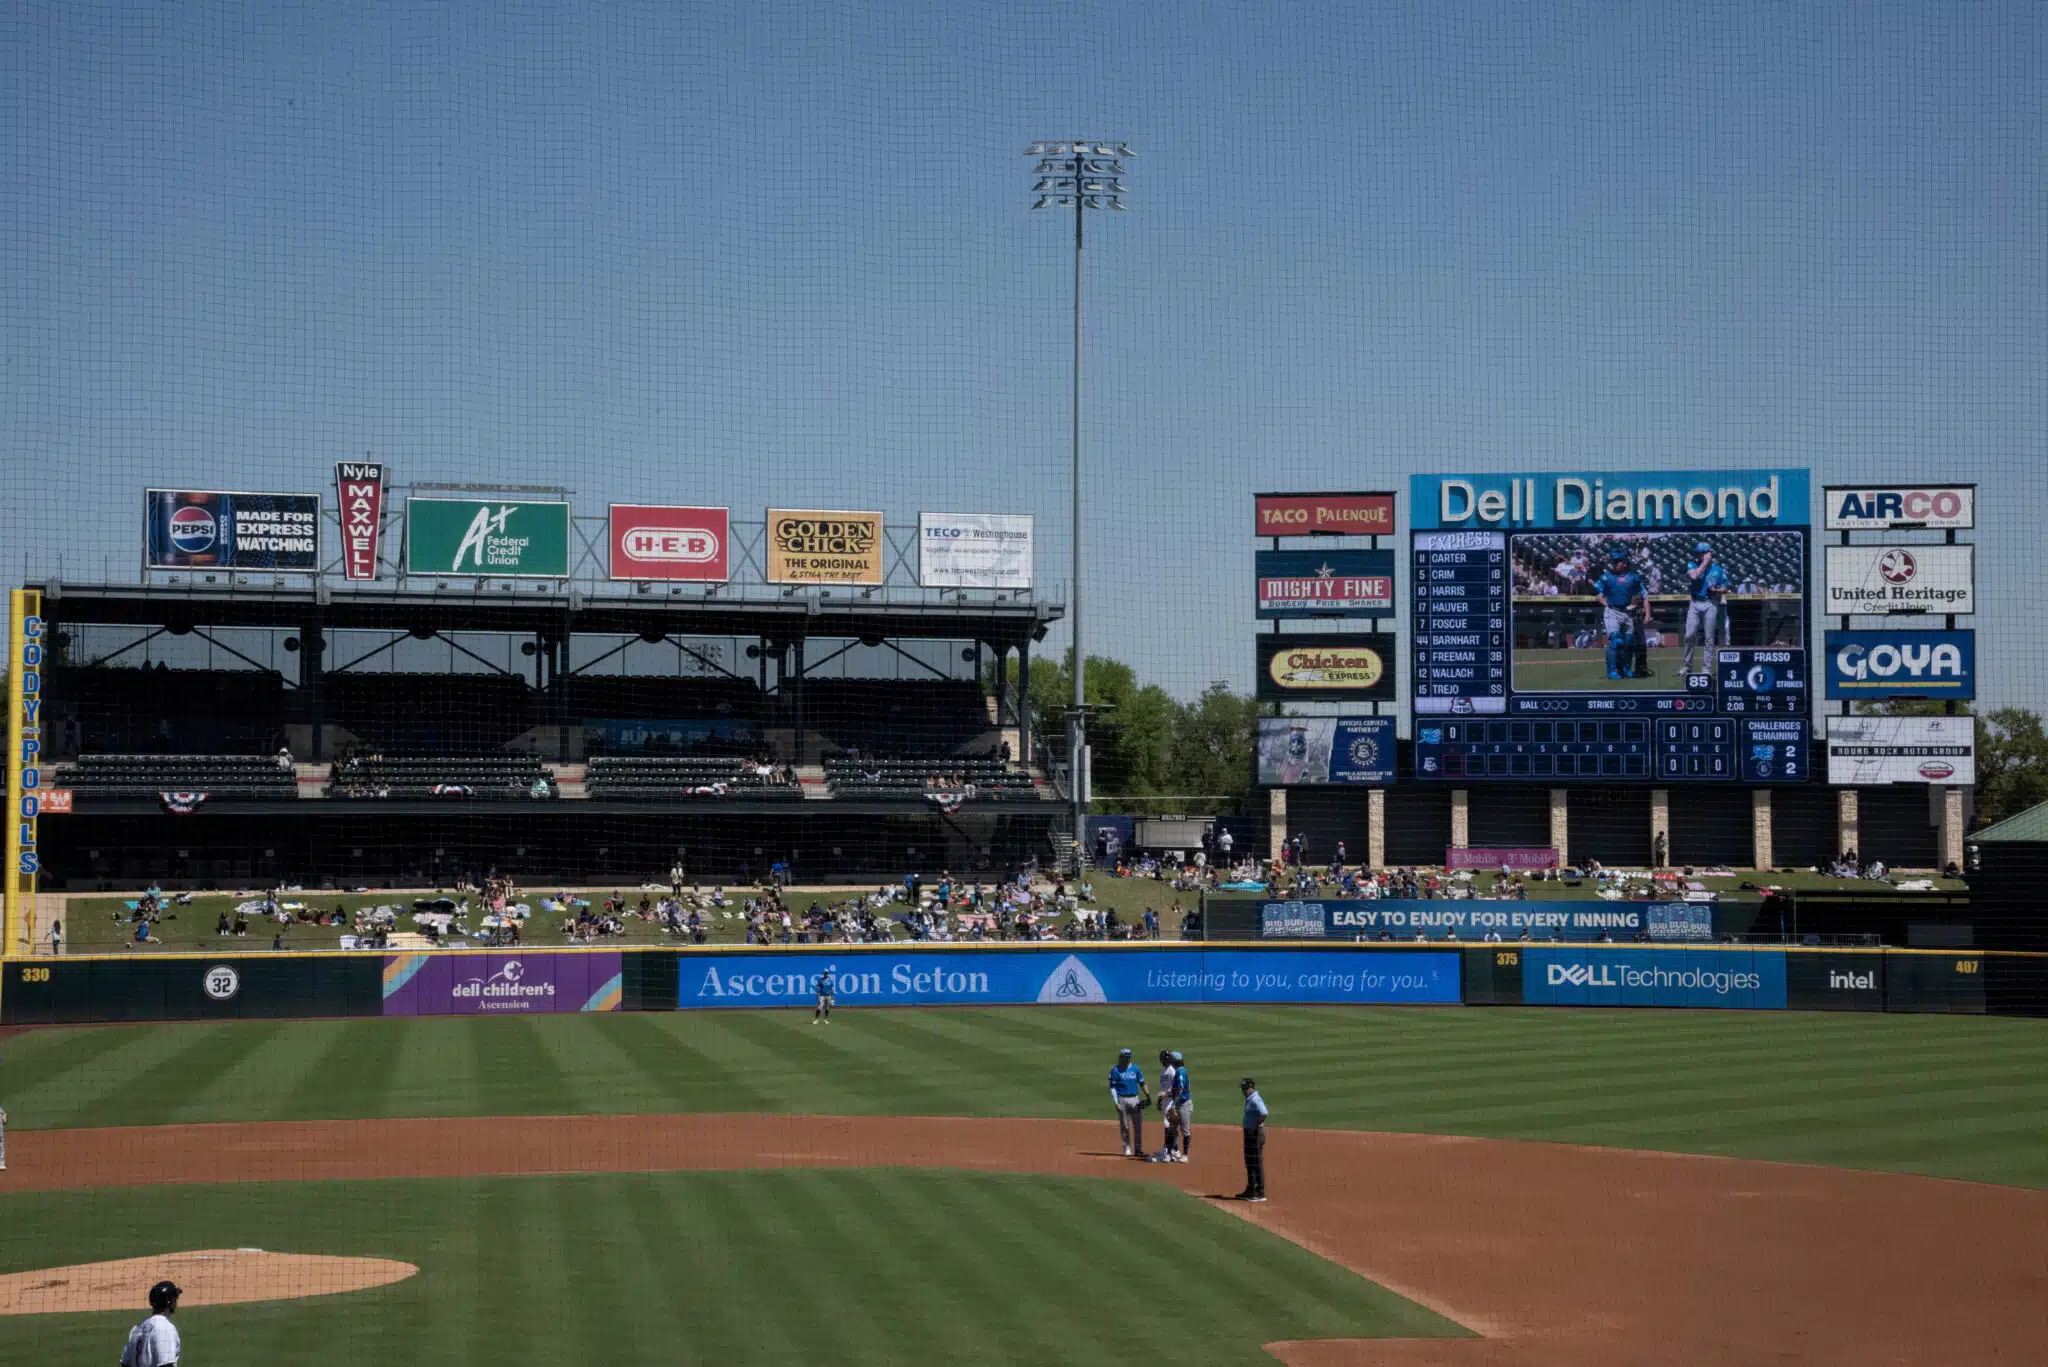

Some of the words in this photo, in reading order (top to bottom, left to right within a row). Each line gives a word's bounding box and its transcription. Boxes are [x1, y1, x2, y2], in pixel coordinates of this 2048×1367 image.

[343, 463, 379, 481] Nyle
[1441, 479, 1534, 522] Dell
[1556, 475, 1779, 521] Diamond
[235, 511, 280, 521] MADE
[283, 511, 313, 523] FOR
[1261, 508, 1308, 524] TACO
[1316, 507, 1388, 524] PALENQUE
[171, 524, 214, 537] PEPSI
[235, 522, 313, 536] EXPRESS
[347, 484, 375, 577] MAXWELL
[778, 519, 875, 539] GOLDEN
[925, 527, 960, 538] TECO
[973, 529, 1028, 542] Westinghouse
[236, 537, 313, 552] WATCHING
[453, 505, 519, 572] A+
[487, 535, 529, 547] Federal
[1428, 531, 1491, 551] EXPRESS
[487, 545, 521, 556] Credit
[786, 536, 861, 555] CHICK
[487, 555, 519, 566] Union
[1419, 553, 1425, 563] 11
[1431, 553, 1467, 563] CARTER
[1489, 553, 1502, 563] CF
[785, 559, 808, 569] THE
[810, 559, 870, 571] ORIGINAL
[799, 571, 821, 581] STILL
[823, 572, 843, 582] THE
[844, 572, 864, 582] BEST
[1418, 569, 1425, 580] 5
[1431, 569, 1455, 580] CRIM
[1491, 569, 1501, 580] 1B
[1267, 579, 1336, 598] MIGHTY
[1344, 580, 1385, 597] FINE
[1417, 586, 1427, 596] 10
[1432, 586, 1466, 596] HARRIS
[1490, 586, 1502, 596] RF
[1831, 585, 1887, 601] United
[1891, 586, 1967, 603] Heritage
[1268, 600, 1308, 608] BURGERS
[1316, 600, 1341, 608] FRIES
[1348, 600, 1382, 608] SHAKES
[1418, 602, 1427, 613] 17
[1432, 602, 1469, 613] HAUVER
[1490, 602, 1502, 613] LF
[1863, 602, 1899, 612] Credit
[1419, 619, 1425, 629] 7
[1432, 619, 1467, 629] FOSCUE
[1490, 619, 1502, 629] 2B
[1416, 635, 1428, 646] 44
[1432, 635, 1480, 646] BARNHART
[1492, 635, 1500, 646] C
[1287, 653, 1369, 670] Chicken
[1419, 651, 1426, 662] 6
[1432, 651, 1476, 662] FREEMAN
[1490, 651, 1503, 662] 3B
[1754, 652, 1791, 662] FRASSO
[1837, 643, 1961, 681] GOYA
[23, 616, 41, 724] CODY
[1327, 671, 1370, 681] EXPRESS
[1418, 667, 1428, 678] 12
[1432, 667, 1474, 678] WALLACH
[1490, 667, 1503, 678] DH
[1730, 670, 1737, 679] 3
[1689, 676, 1708, 687] 85
[1418, 684, 1428, 695] 15
[1432, 684, 1460, 695] TREJO
[1490, 684, 1503, 695] SS
[1520, 701, 1538, 709] BALL
[1587, 700, 1615, 709] STRIKE
[1657, 700, 1673, 709] OUT
[1788, 702, 1794, 711] 3
[1748, 721, 1801, 731] CHALLENGES
[1449, 726, 1456, 739] 0
[1669, 726, 1677, 738] 0
[1692, 726, 1699, 738] 0
[1714, 726, 1722, 738] 0
[1752, 731, 1799, 741] REMAINING
[1471, 744, 1477, 753] 2
[1540, 744, 1546, 753] 5
[1714, 745, 1719, 753] E
[1785, 745, 1796, 758] 2
[1902, 747, 1928, 755] AUTO
[1670, 759, 1677, 772] 0
[1693, 759, 1698, 772] 1
[1714, 759, 1722, 772] 0
[1785, 762, 1797, 775] 2
[20, 738, 40, 875] POOLS
[1463, 853, 1498, 865] Mobile
[1265, 920, 1283, 928] BUD
[1284, 918, 1304, 927] BUD
[1304, 920, 1324, 928] BUD
[1332, 911, 1378, 926] EASY
[1382, 912, 1406, 926] TO
[1409, 912, 1467, 927] ENJOY
[1471, 912, 1508, 927] FOR
[1511, 912, 1569, 927] EVERY
[1573, 912, 1640, 927] INNING
[1691, 922, 1710, 930] BUD
[1496, 953, 1517, 966] 375
[1955, 960, 1977, 973] 407
[22, 967, 50, 982] 330
[891, 963, 989, 994] Seton
[1147, 969, 1225, 990] Listening
[1231, 971, 1249, 987] to
[1254, 975, 1291, 992] you,
[1297, 970, 1353, 991] caring
[1359, 969, 1385, 991] for
[1388, 974, 1427, 991] you.
[1547, 963, 1616, 986] DELL
[1615, 965, 1760, 994] Technologies
[212, 977, 231, 993] 32
[451, 983, 480, 998] dell
[483, 981, 556, 997] children's
[478, 1001, 529, 1010] Ascension
